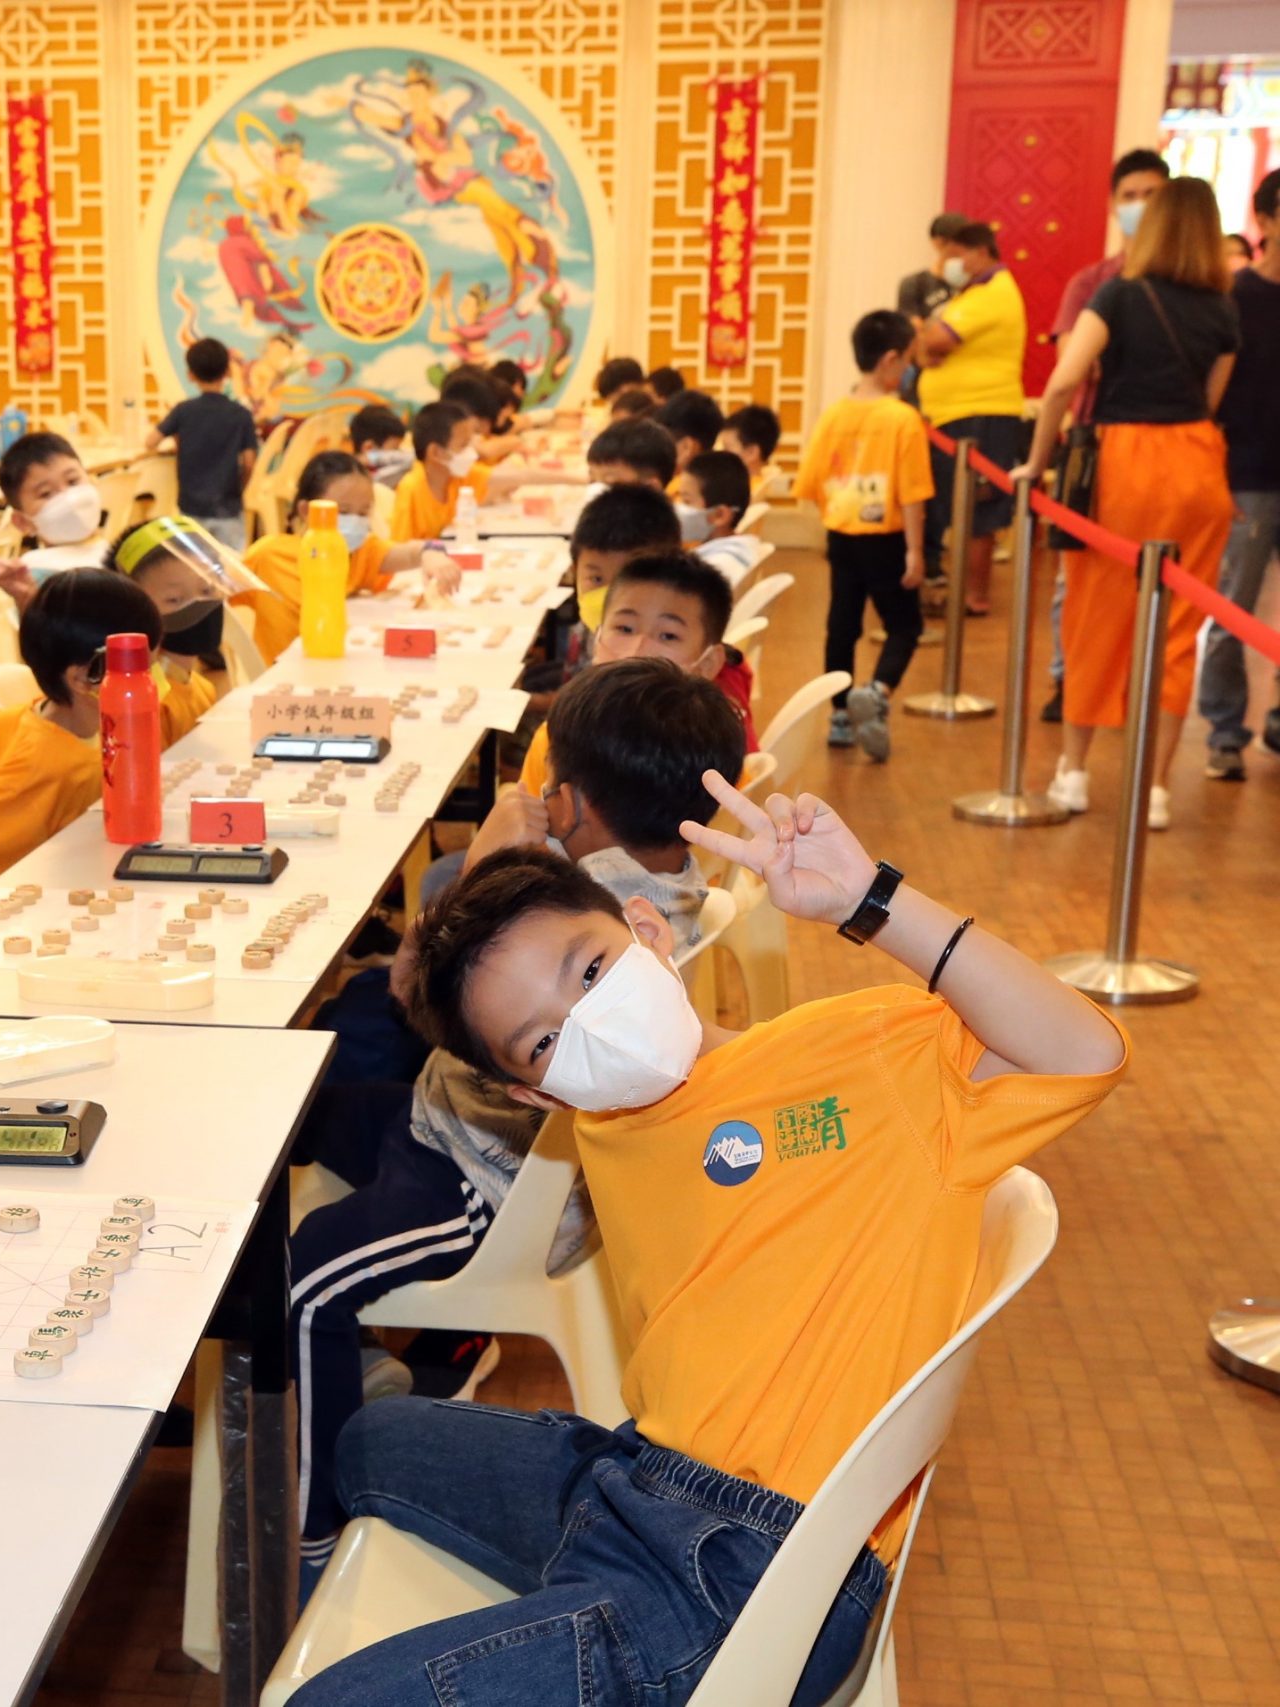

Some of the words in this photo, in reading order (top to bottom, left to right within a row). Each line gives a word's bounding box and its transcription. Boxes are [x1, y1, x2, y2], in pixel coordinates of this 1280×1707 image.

[266, 704, 375, 721] 小学低年级组
[218, 812, 233, 838] 3
[778, 1145, 821, 1163] YOUTH
[139, 1221, 208, 1262] A2
